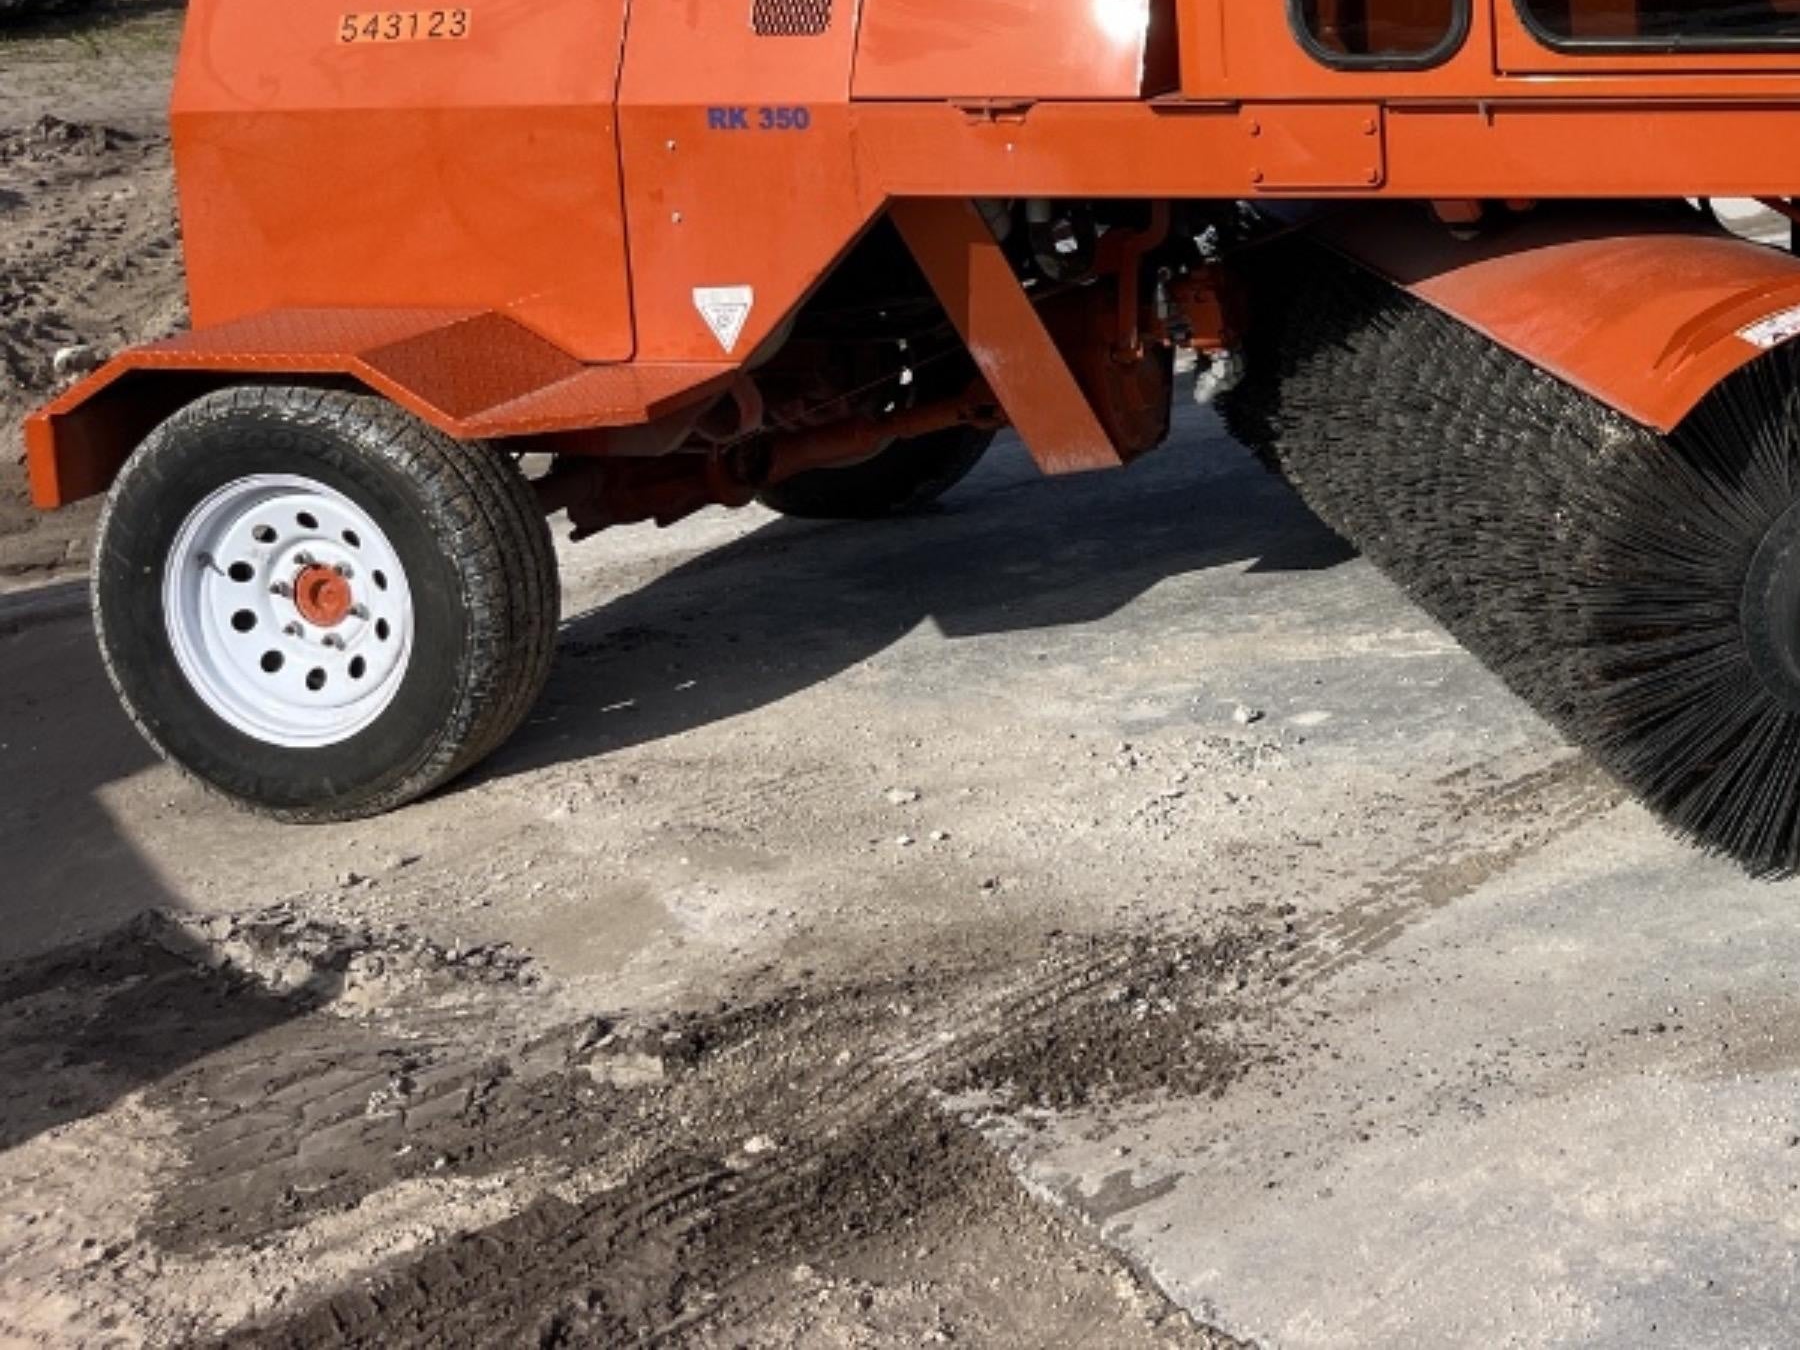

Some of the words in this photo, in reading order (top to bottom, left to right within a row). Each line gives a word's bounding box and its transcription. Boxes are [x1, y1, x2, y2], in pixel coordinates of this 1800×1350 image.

[340, 10, 469, 44] 543123
[707, 106, 750, 130] RK
[758, 106, 810, 130] 350
